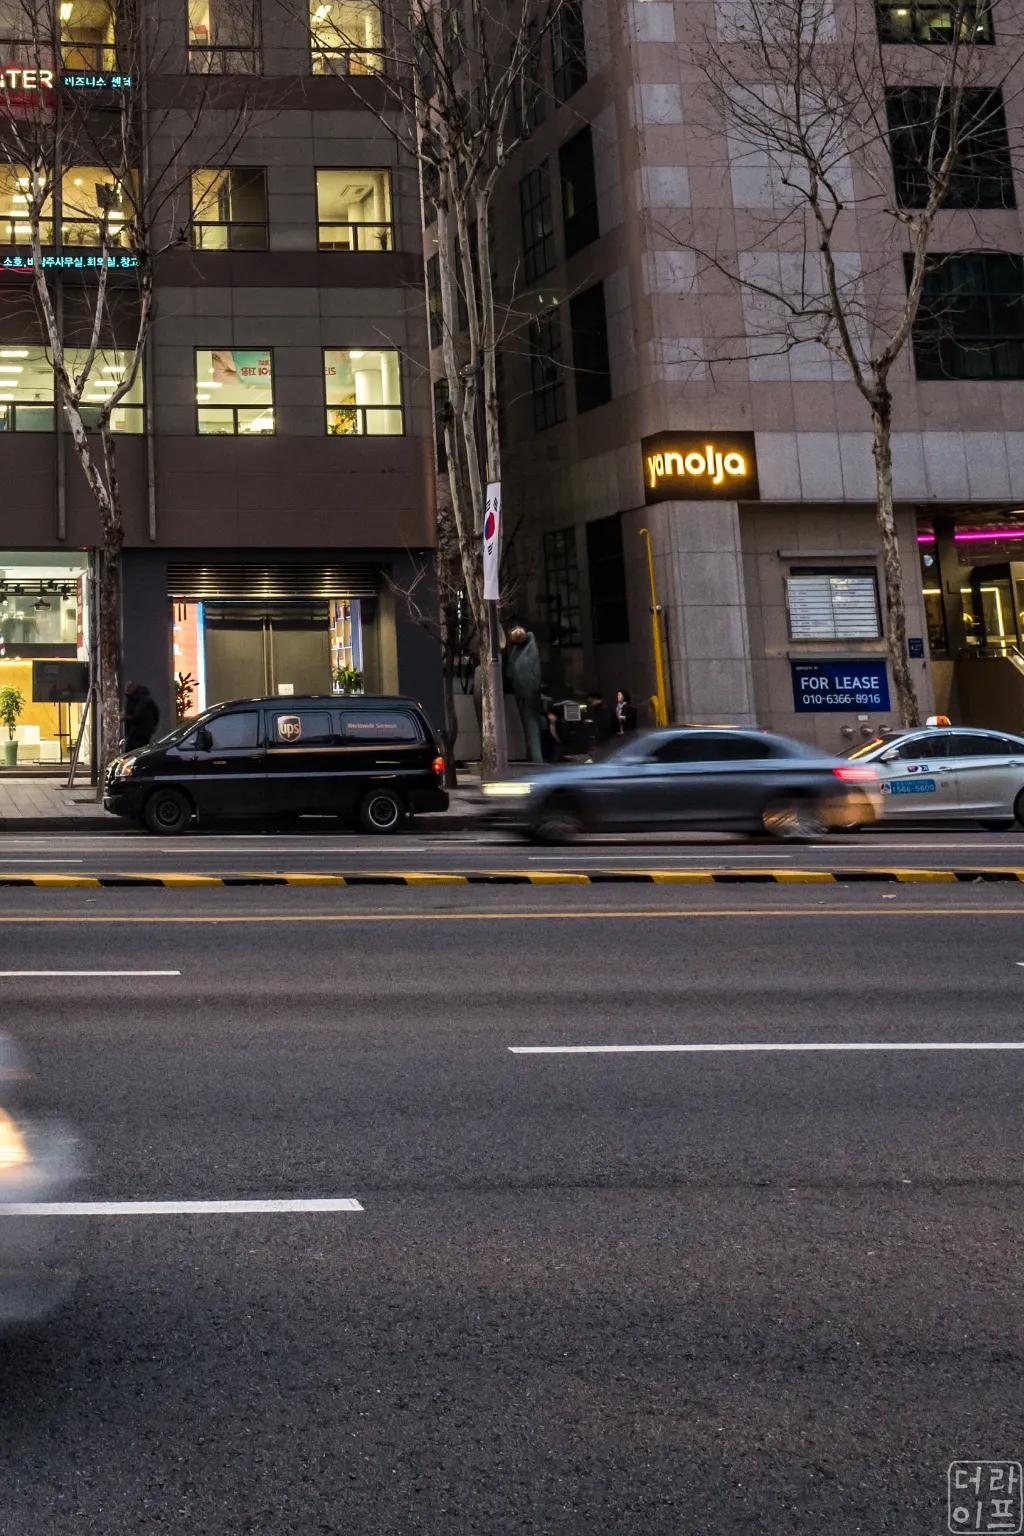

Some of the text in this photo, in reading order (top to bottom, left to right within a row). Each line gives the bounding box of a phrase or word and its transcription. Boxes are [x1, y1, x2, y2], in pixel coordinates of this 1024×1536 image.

[64, 76, 131, 88] 비즈니스 센터
[647, 445, 746, 488] yanolja
[801, 676, 880, 690] FOR LEASE
[802, 693, 881, 705] 010-6366-8916
[280, 723, 301, 739] ups
